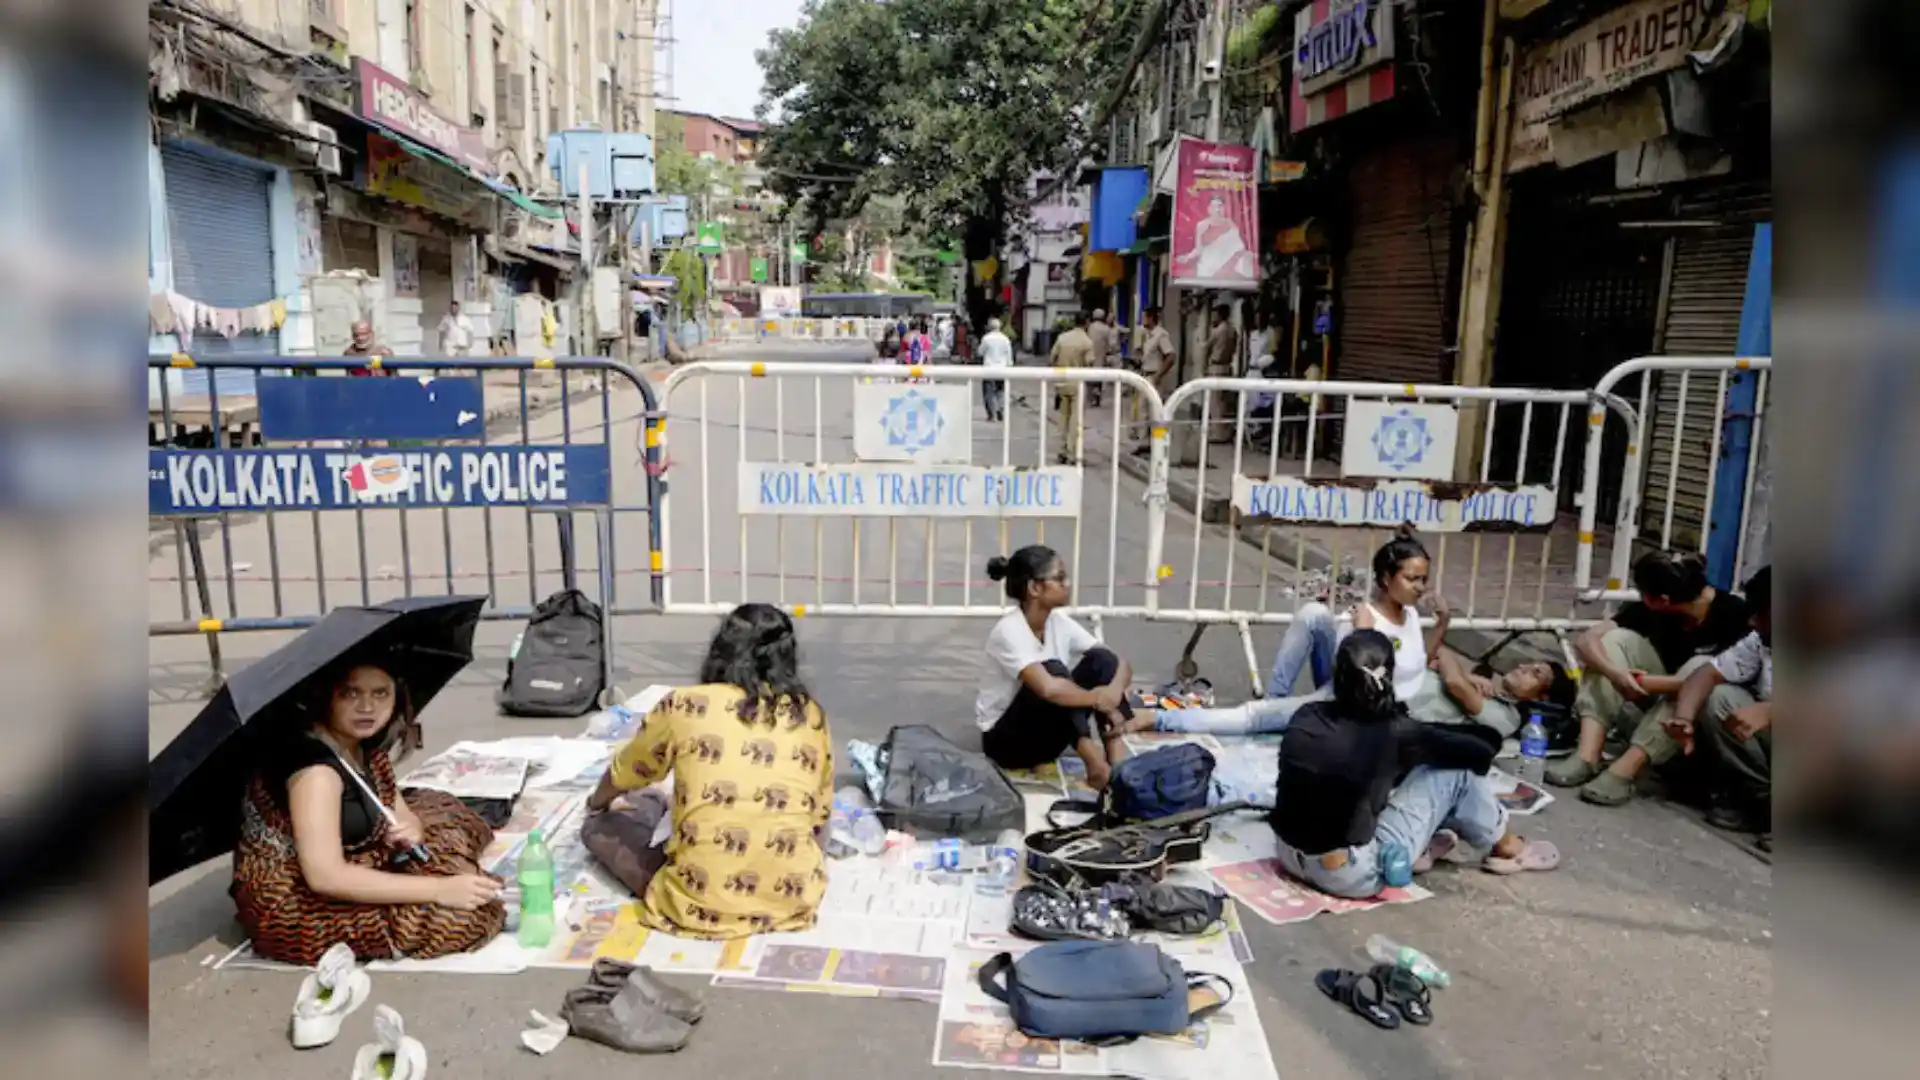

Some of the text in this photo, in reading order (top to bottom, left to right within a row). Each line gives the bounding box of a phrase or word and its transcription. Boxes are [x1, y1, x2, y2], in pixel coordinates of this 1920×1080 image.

[168, 453, 320, 507] KOLKATA
[461, 451, 567, 503] POLICE
[760, 471, 1063, 506] KOLKATA TRAFFIC POLICE
[1250, 485, 1537, 525] KOLKATA TRAFFIC POLICE
